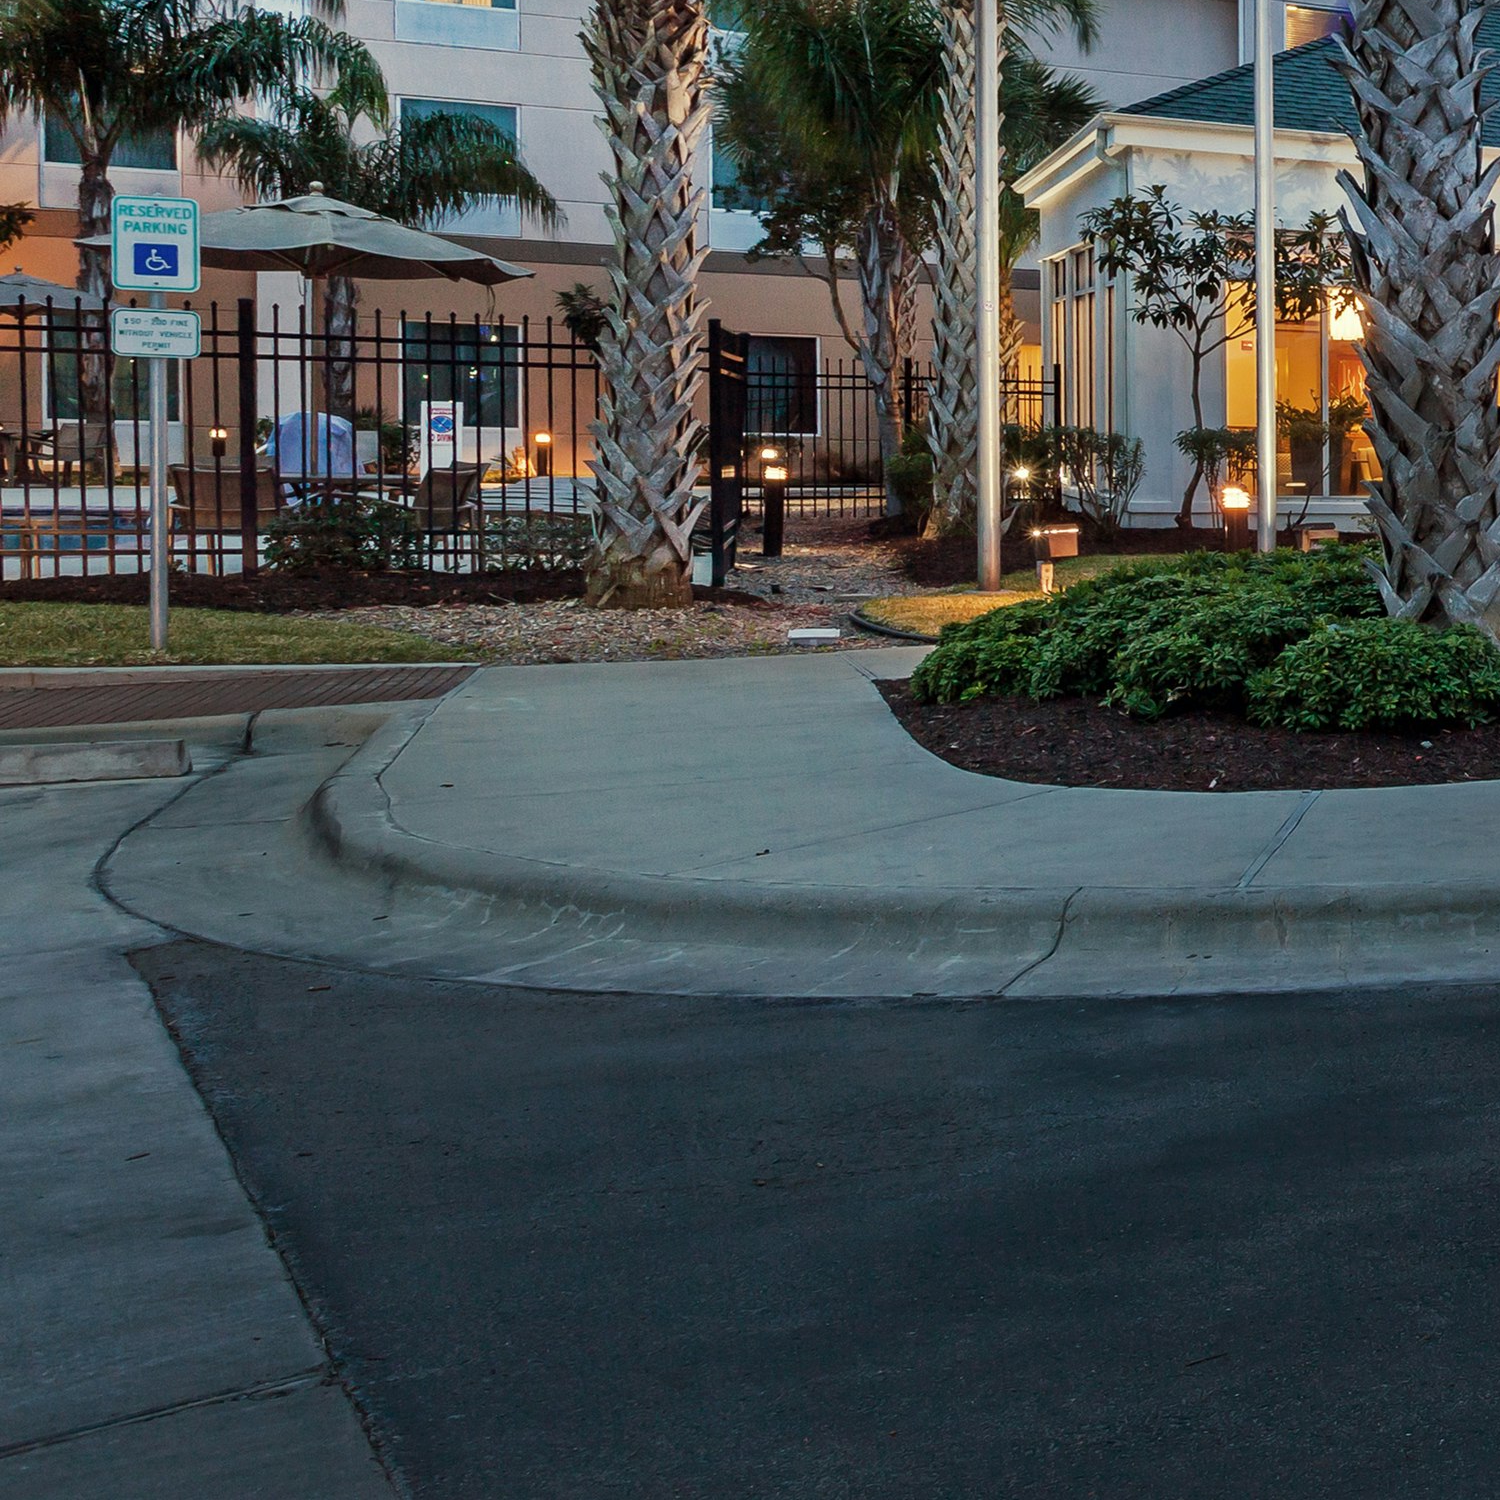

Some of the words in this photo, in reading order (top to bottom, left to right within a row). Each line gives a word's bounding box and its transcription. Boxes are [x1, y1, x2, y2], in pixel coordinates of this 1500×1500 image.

[119, 205, 192, 220] RESERVED
[124, 220, 187, 235] PARKING
[142, 341, 171, 349] PERMIT
